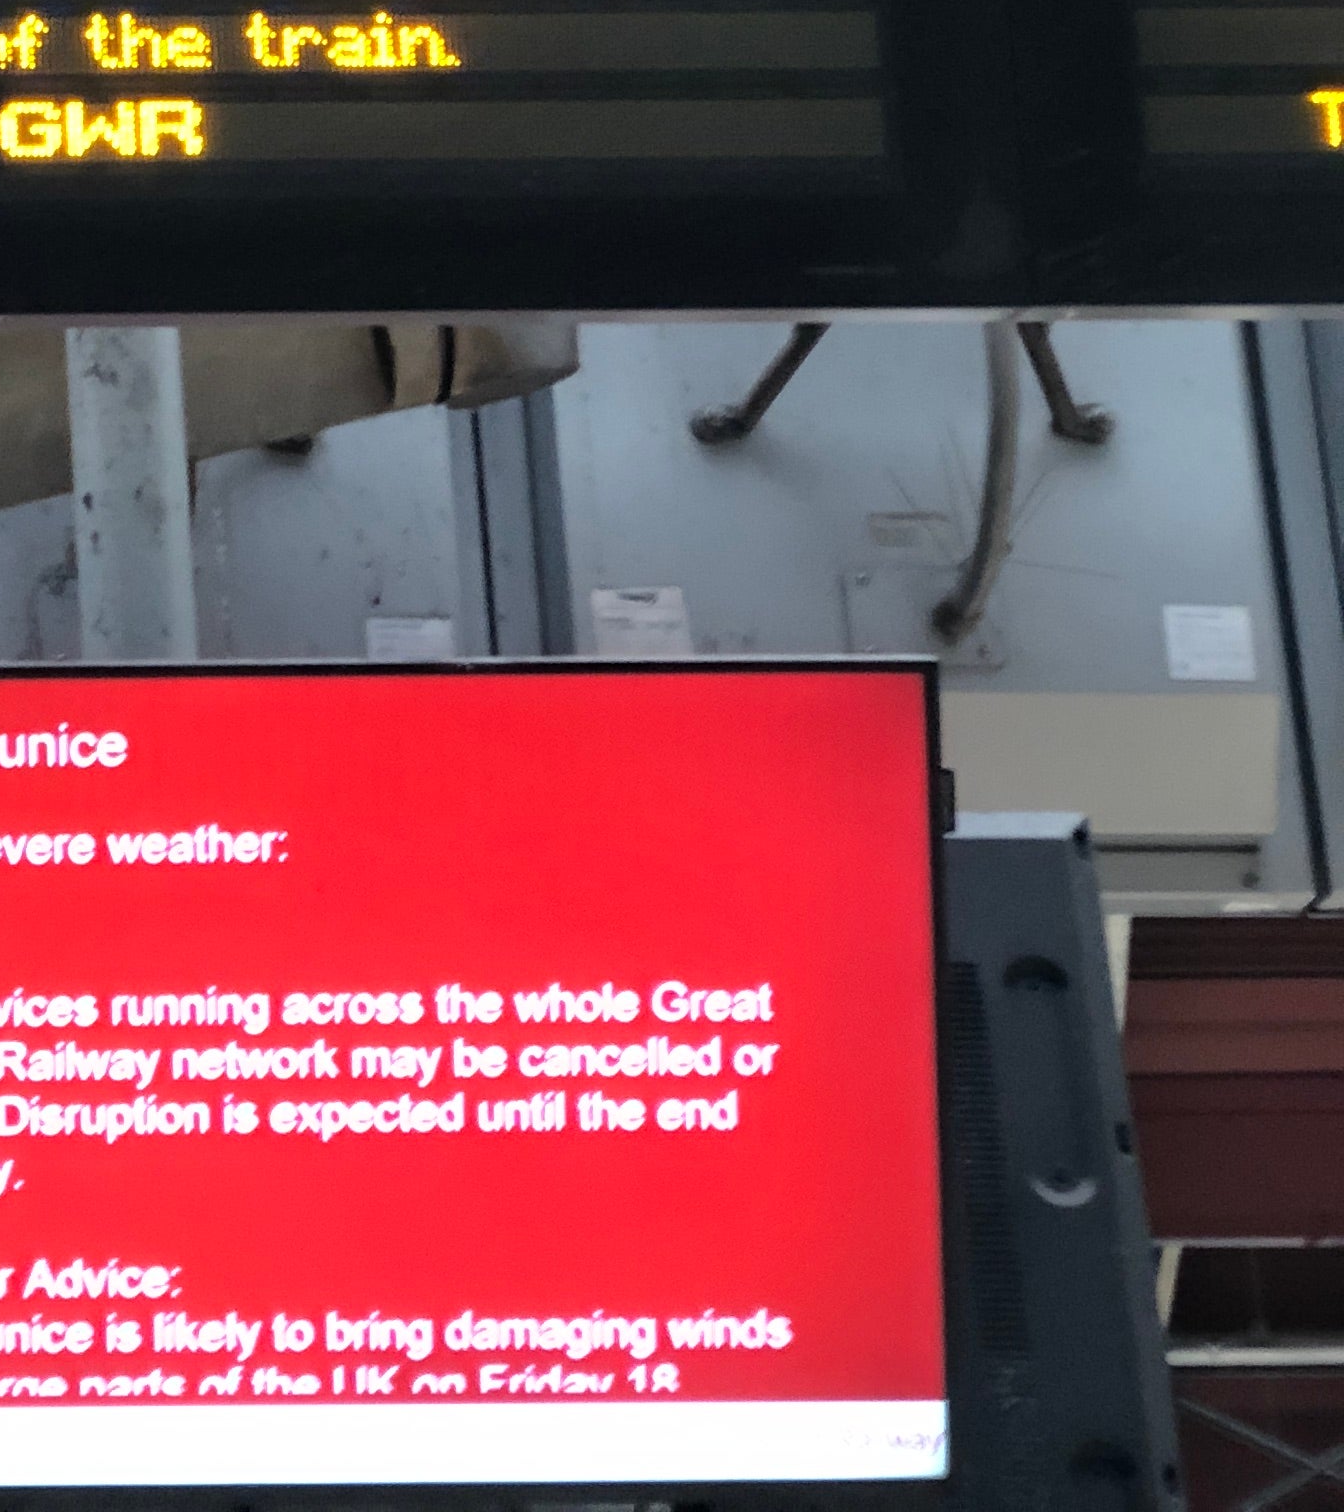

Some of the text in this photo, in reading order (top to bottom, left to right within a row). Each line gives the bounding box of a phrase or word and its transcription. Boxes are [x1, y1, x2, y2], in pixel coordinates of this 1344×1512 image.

[82, 12, 214, 71] the
[105, 822, 289, 865] weather:
[110, 984, 271, 1036] running
[280, 990, 426, 1026] across
[433, 982, 505, 1025] the
[512, 980, 641, 1024] whole
[650, 979, 775, 1024] Great
[170, 1037, 341, 1081] network
[350, 1044, 444, 1089] may
[451, 1036, 509, 1079] be
[517, 1034, 723, 1079] cancelled
[732, 1042, 781, 1077] or
[222, 1092, 261, 1135] is
[267, 1090, 466, 1143] expected
[476, 1090, 567, 1133] until
[575, 1089, 648, 1133] the
[655, 1089, 739, 1132] end
[21, 1257, 183, 1300] Advice:
[104, 1311, 144, 1354] is
[152, 1310, 263, 1363] likely
[270, 1311, 316, 1353] to
[324, 1309, 435, 1362] bring
[443, 1308, 658, 1361] damaging
[665, 1307, 794, 1350] winds
